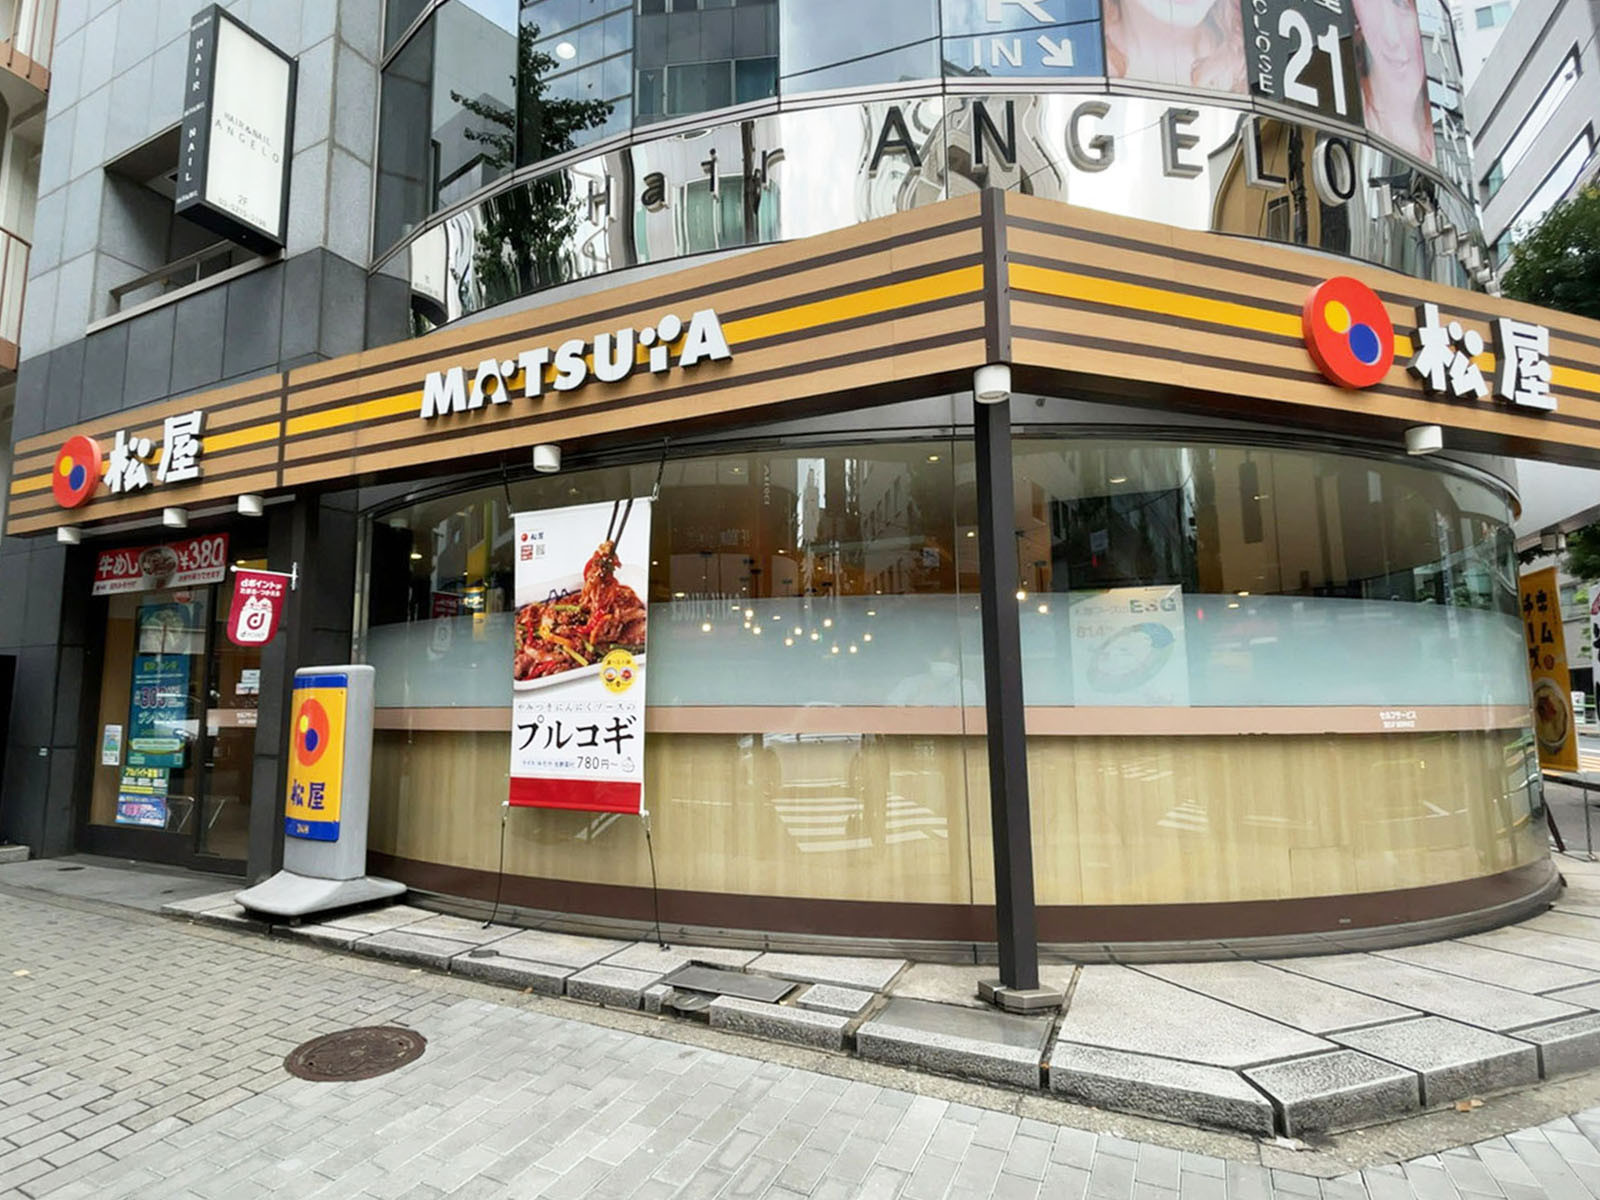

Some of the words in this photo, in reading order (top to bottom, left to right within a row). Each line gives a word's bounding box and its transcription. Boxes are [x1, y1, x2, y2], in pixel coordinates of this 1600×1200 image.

[192, 38, 204, 92] HAIR
[973, 38, 1022, 67] IN
[1278, 8, 1347, 116] 21
[184, 127, 198, 182] NAIL
[213, 119, 281, 164] ANGELO
[587, 148, 786, 226] Hair
[869, 97, 1358, 208] ANGELO
[419, 307, 734, 420] MATSUYA
[1411, 301, 1558, 412] 松屋
[103, 410, 204, 494] 松屋
[98, 552, 139, 579] 牛めし
[180, 537, 225, 571] ¥380
[517, 714, 637, 755] プルコギ
[290, 778, 326, 811] 松屋
